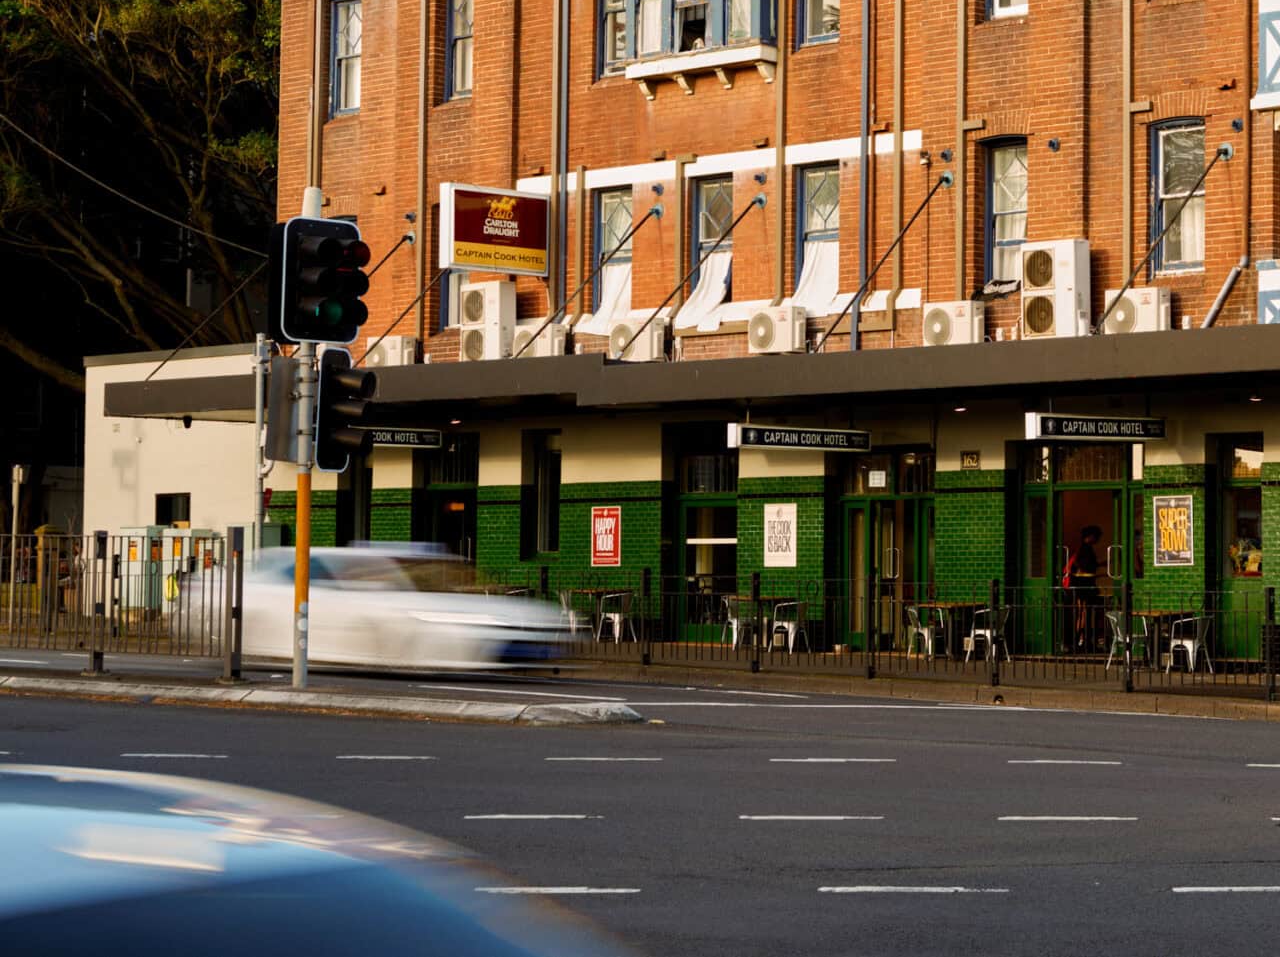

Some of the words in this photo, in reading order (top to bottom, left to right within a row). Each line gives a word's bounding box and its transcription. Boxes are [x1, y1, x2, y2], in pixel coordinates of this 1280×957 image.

[485, 218, 518, 229] CARLTON
[483, 225, 520, 238] DRAUGHT
[455, 248, 492, 260] CAPTAIN
[493, 251, 518, 261] COOK
[518, 254, 545, 265] HOTEL
[1062, 420, 1096, 434] CAPTAIN
[1097, 422, 1119, 435] COOK
[1120, 422, 1145, 435] HOTEL
[394, 432, 419, 444] HOTEL
[763, 431, 798, 444] CAPTAIN
[800, 432, 822, 445] COOK
[823, 433, 848, 446] HOTEL
[963, 454, 977, 468] 162
[594, 517, 616, 534] HAPPY
[776, 520, 792, 535] COOK
[596, 534, 614, 551] HOUR
[774, 535, 792, 552] BACK
[1160, 529, 1189, 552] BOWL
